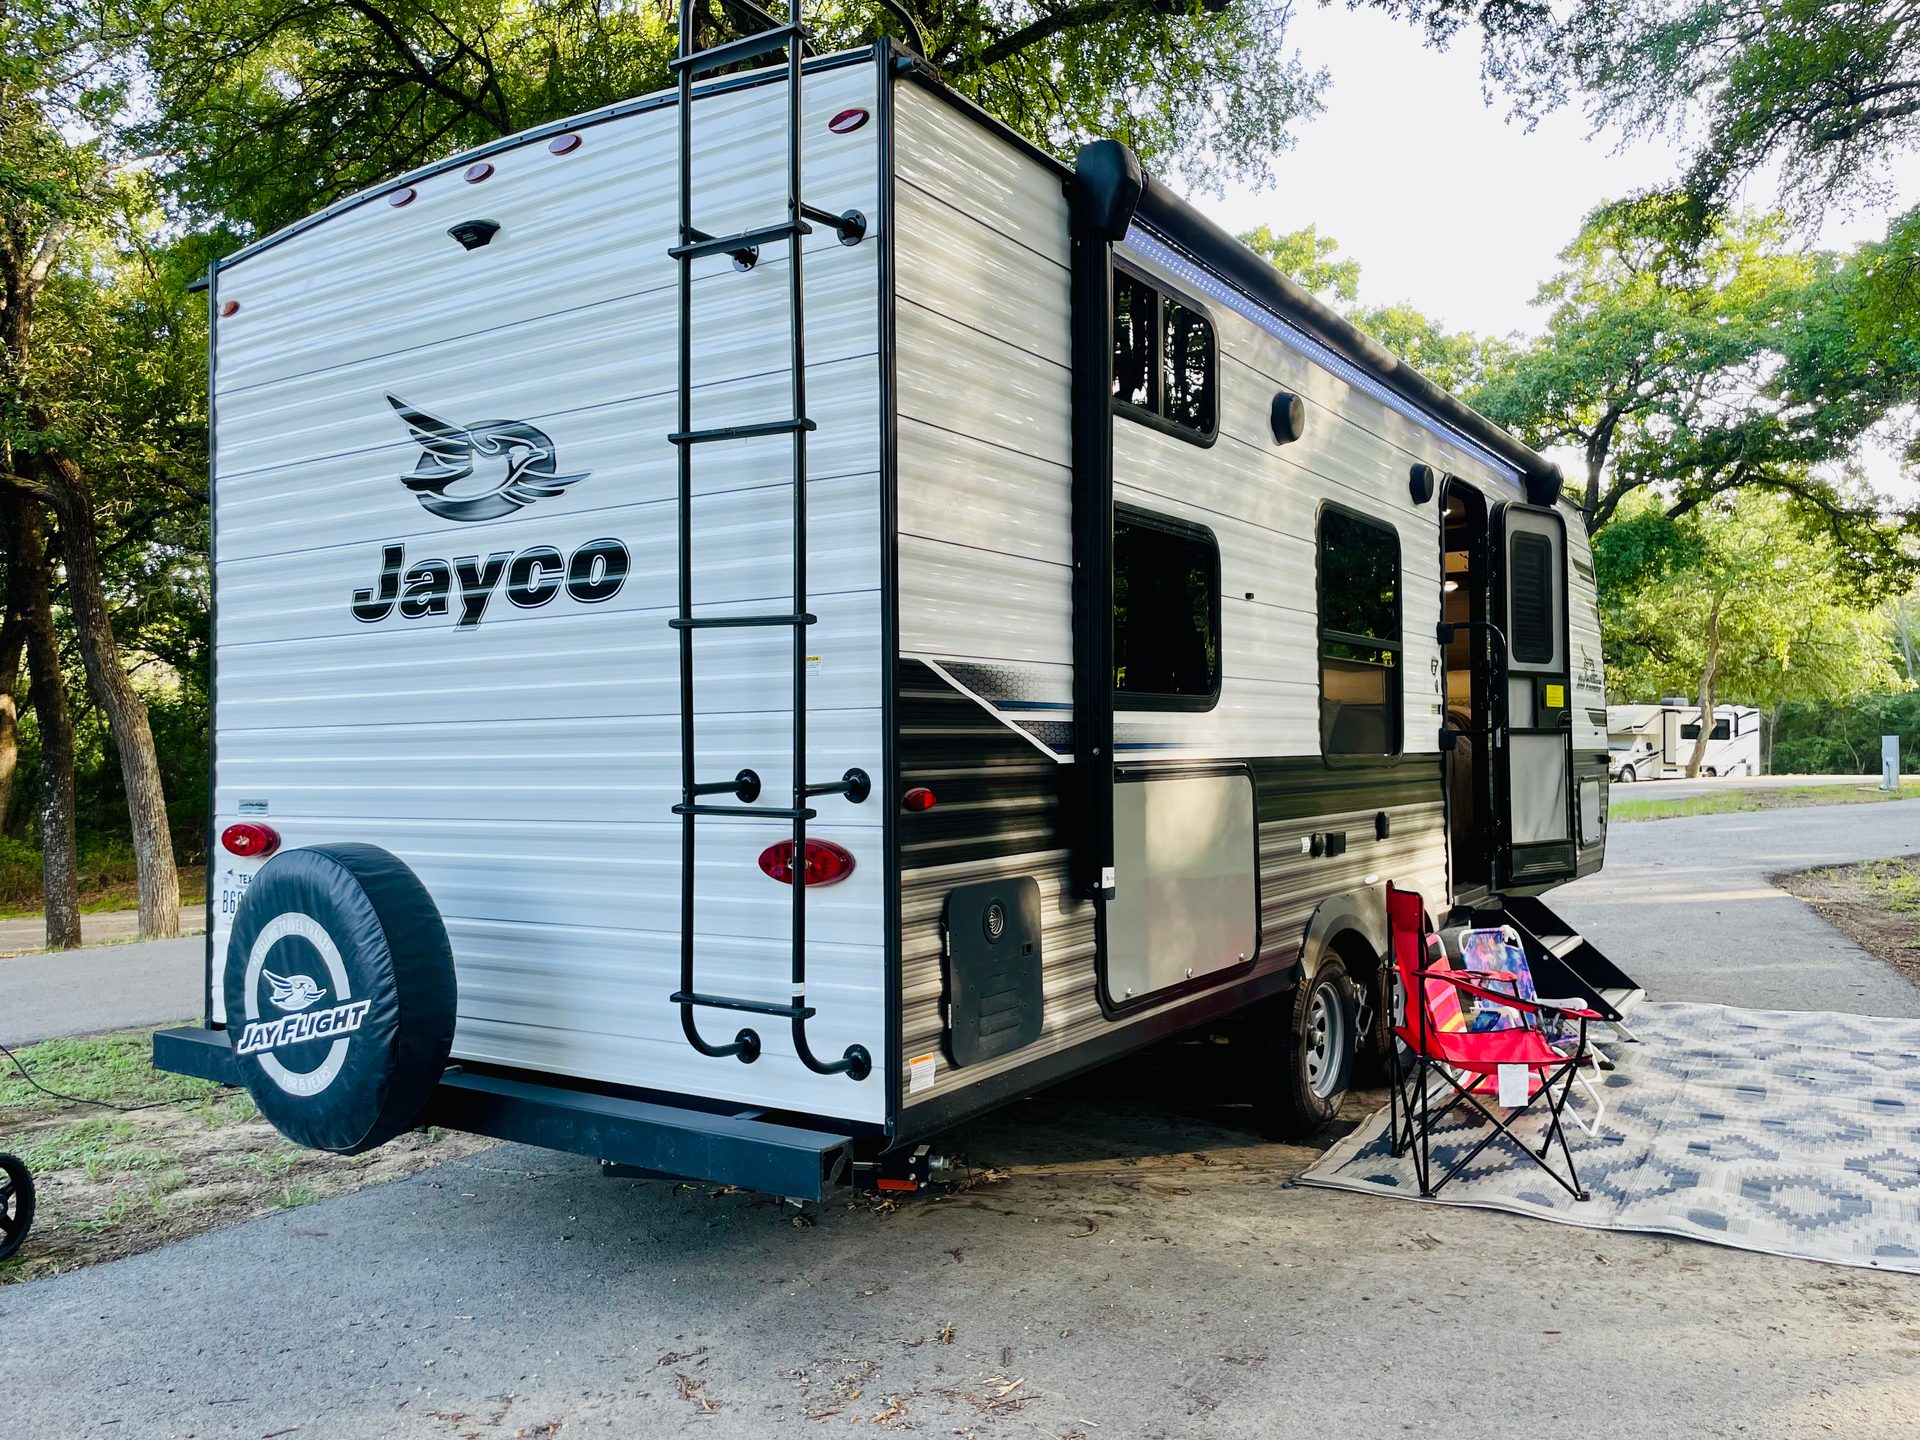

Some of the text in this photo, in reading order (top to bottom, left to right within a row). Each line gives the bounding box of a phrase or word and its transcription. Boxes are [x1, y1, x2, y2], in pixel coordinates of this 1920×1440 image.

[350, 537, 631, 632] Jayco
[239, 874, 253, 884] TEX
[256, 925, 279, 958] SELLING
[279, 918, 304, 935] TRAVEL
[306, 921, 332, 955] TRAILER
[306, 1066, 331, 1090] YEARS
